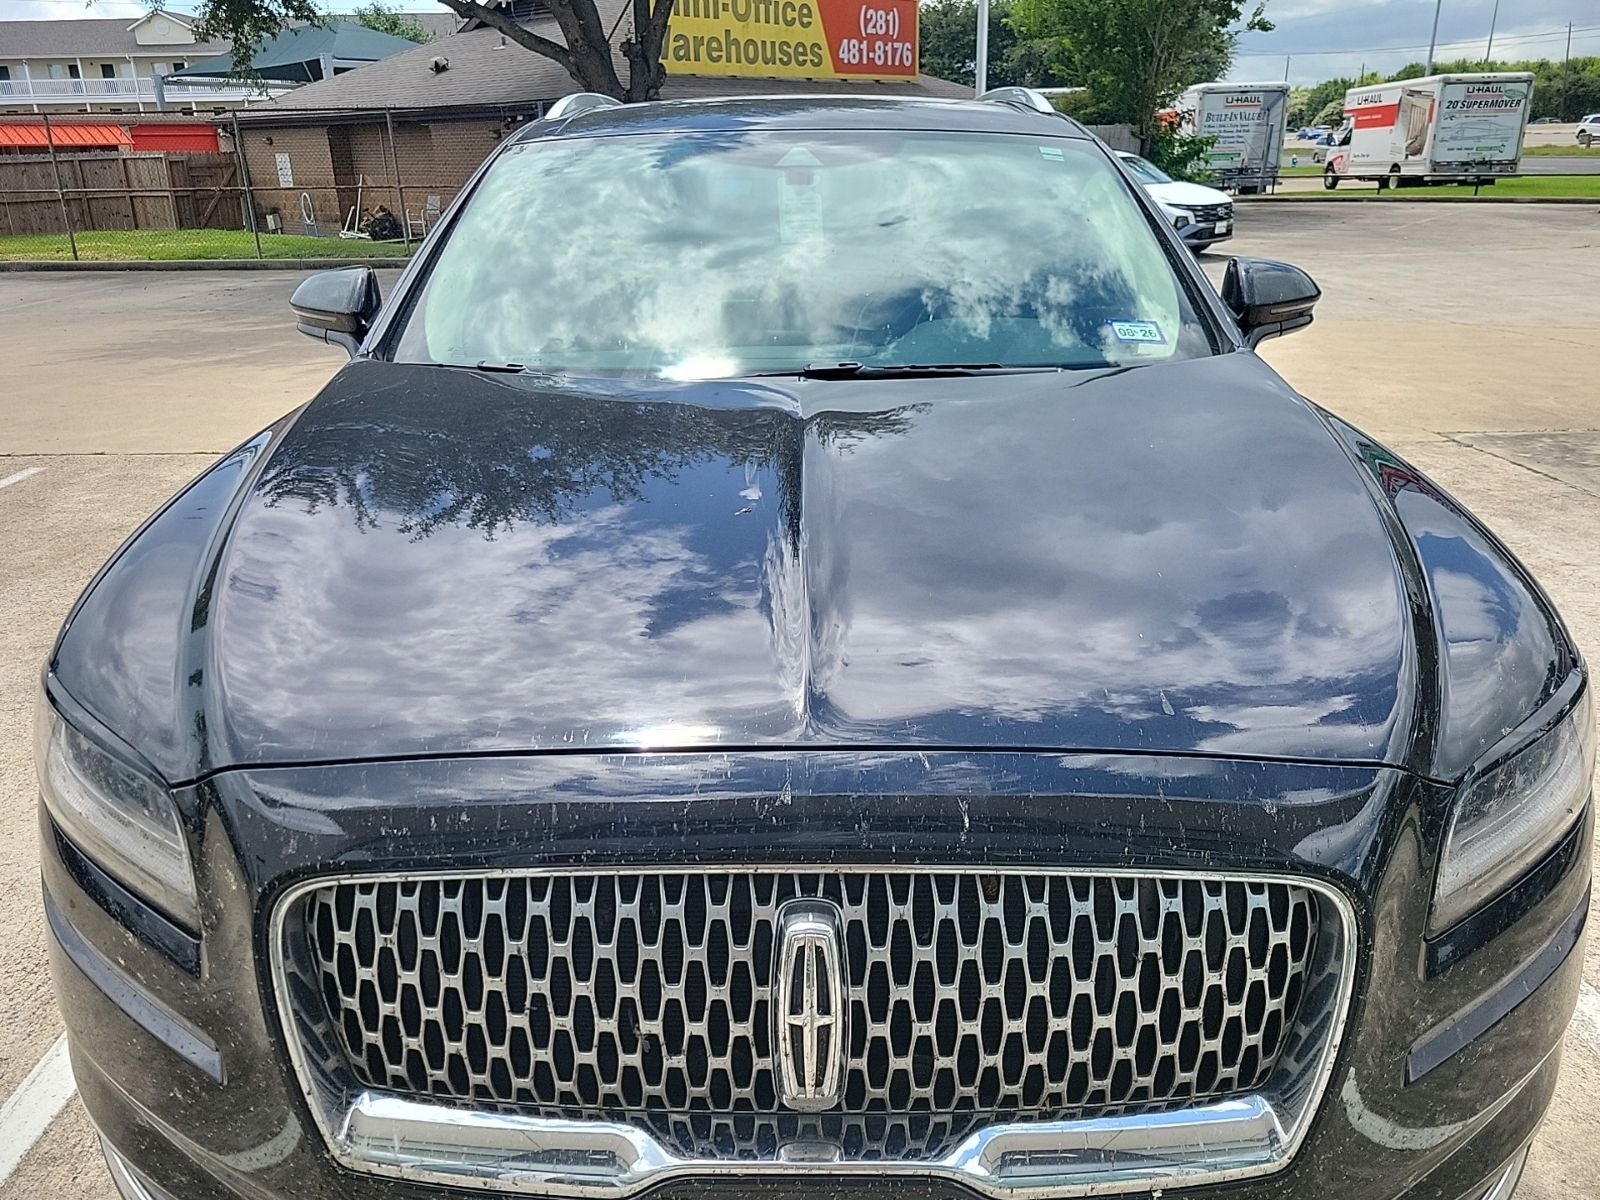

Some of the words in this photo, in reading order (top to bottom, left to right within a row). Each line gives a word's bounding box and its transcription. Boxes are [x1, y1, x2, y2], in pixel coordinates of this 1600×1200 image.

[673, 0, 813, 29] ini-Office
[859, 4, 900, 39] (281)
[838, 38, 913, 67] 481-8176
[1460, 99, 1522, 109] SUPERMOVER
